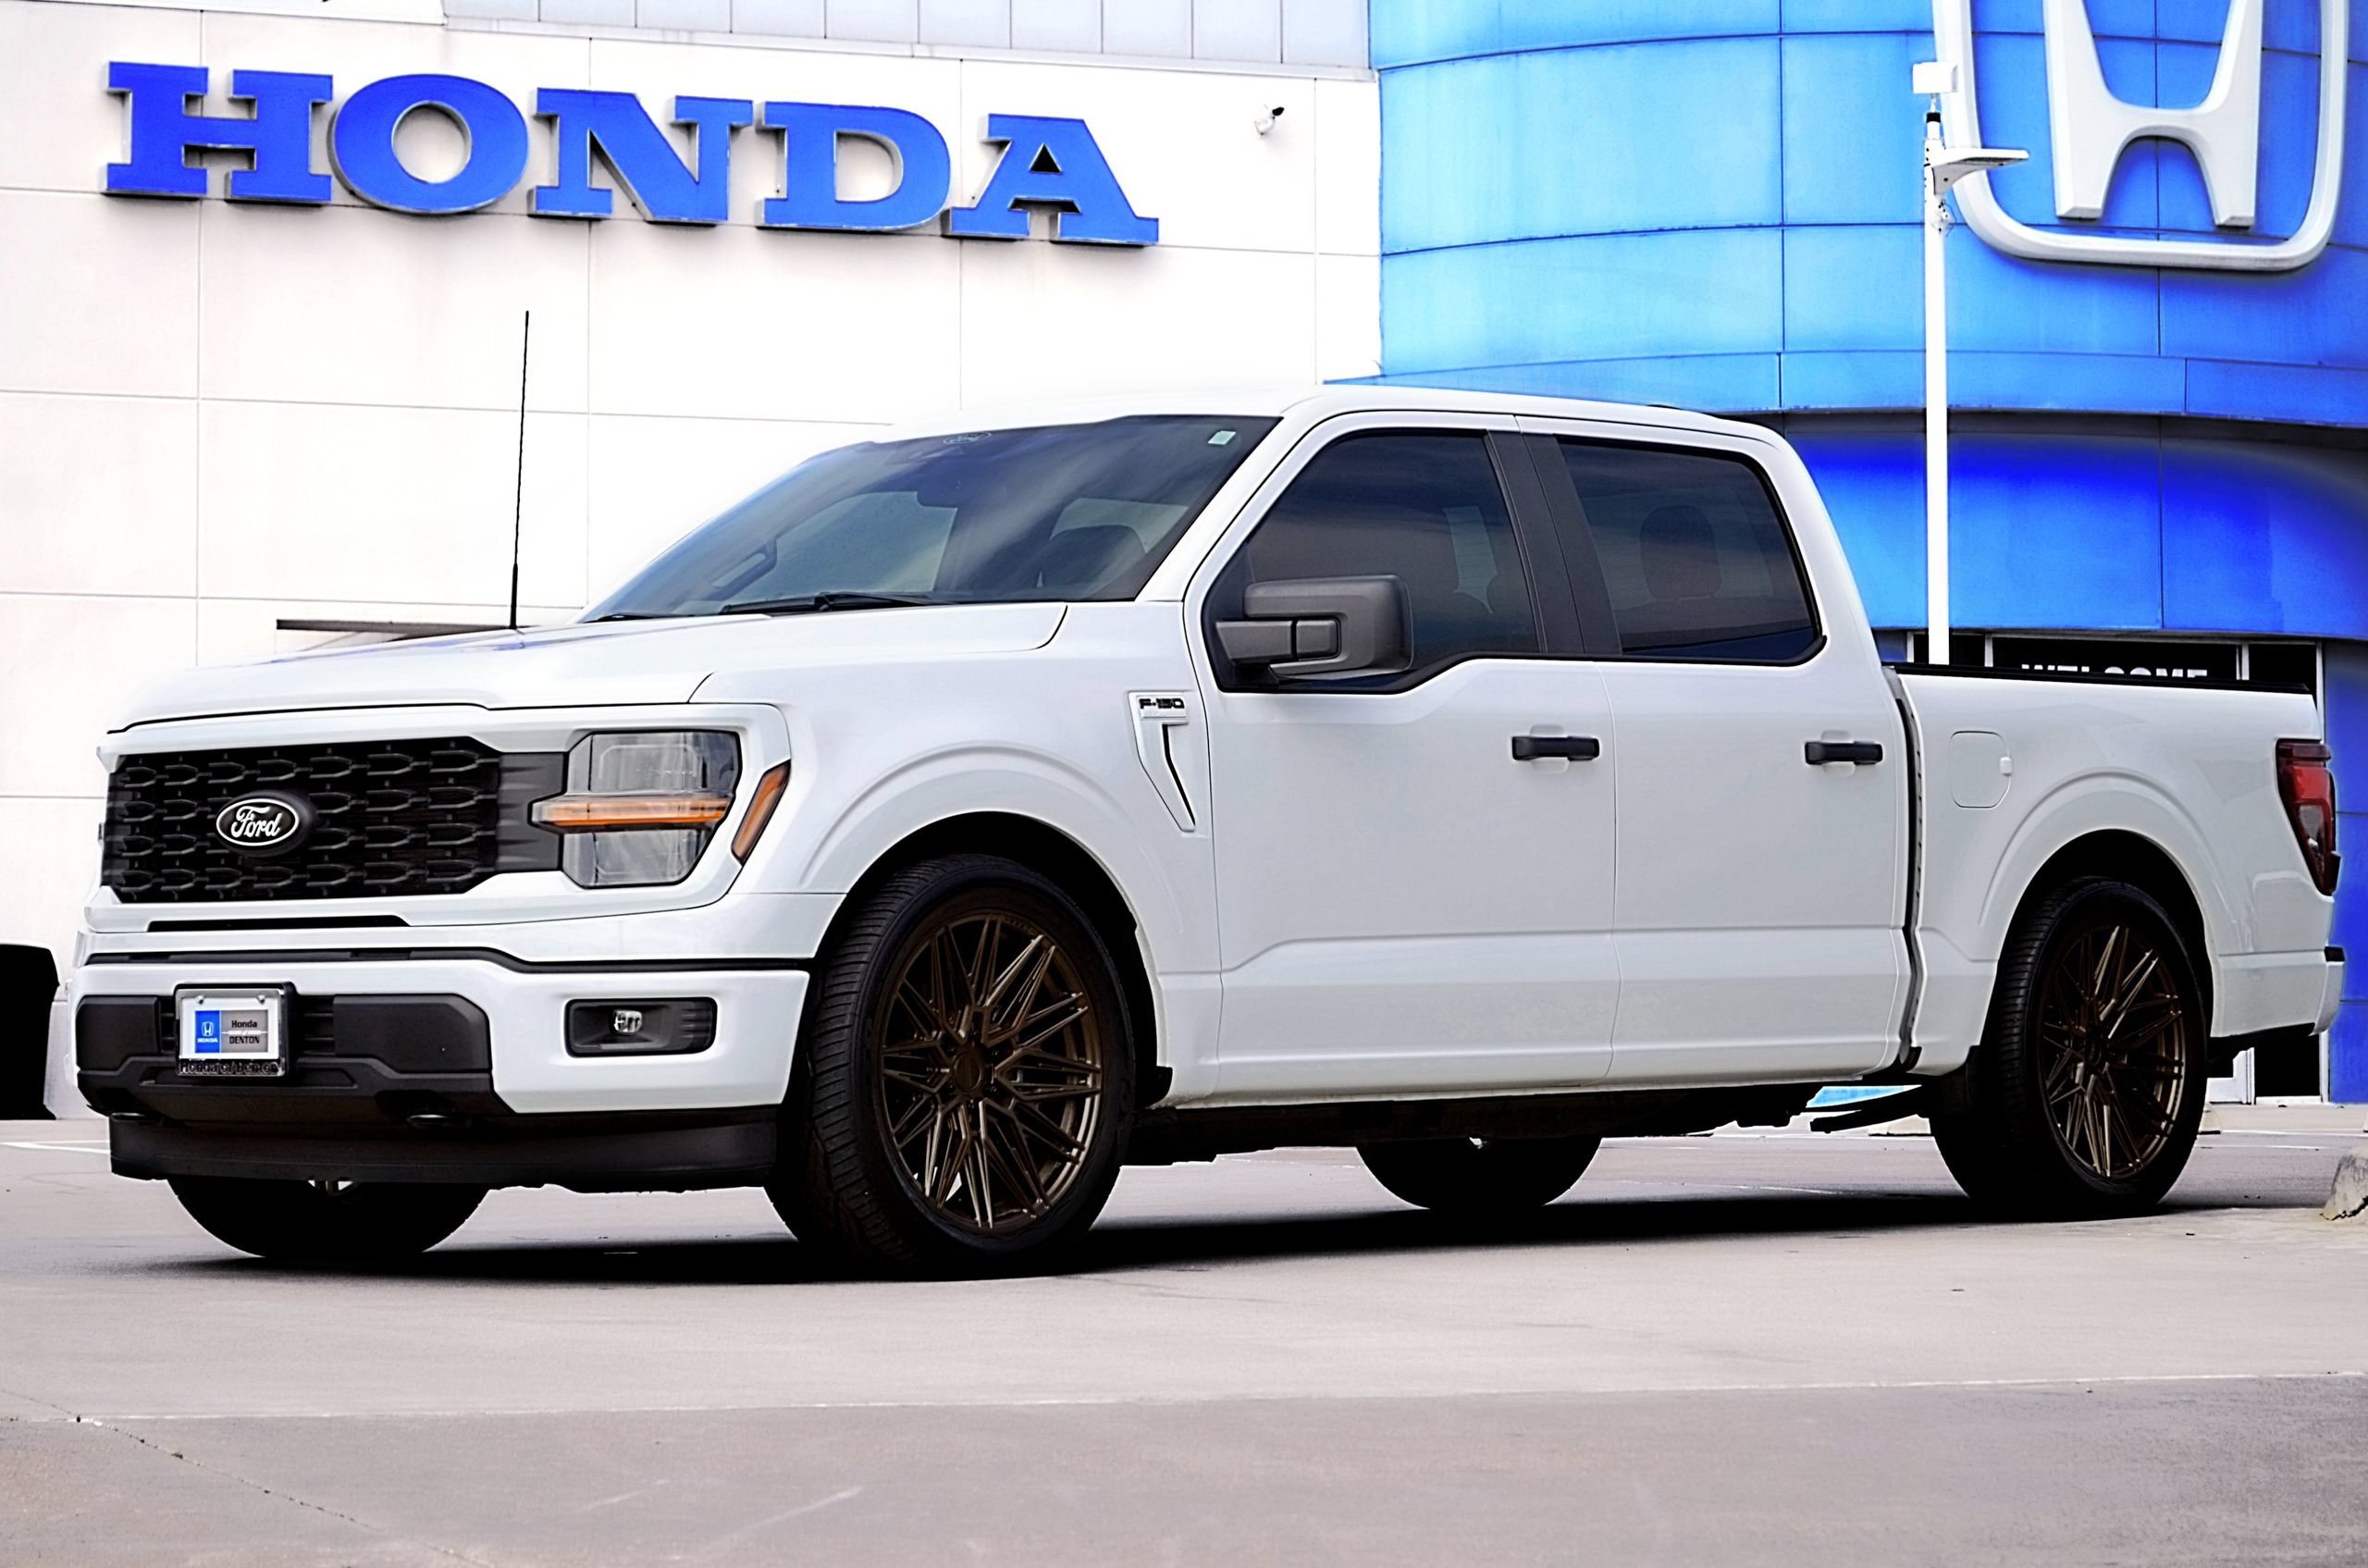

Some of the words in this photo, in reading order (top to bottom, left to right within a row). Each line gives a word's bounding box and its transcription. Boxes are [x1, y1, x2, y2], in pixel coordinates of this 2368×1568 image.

[104, 60, 1160, 246] HONDA
[1139, 698, 1185, 709] F-150
[230, 805, 282, 838] Ford
